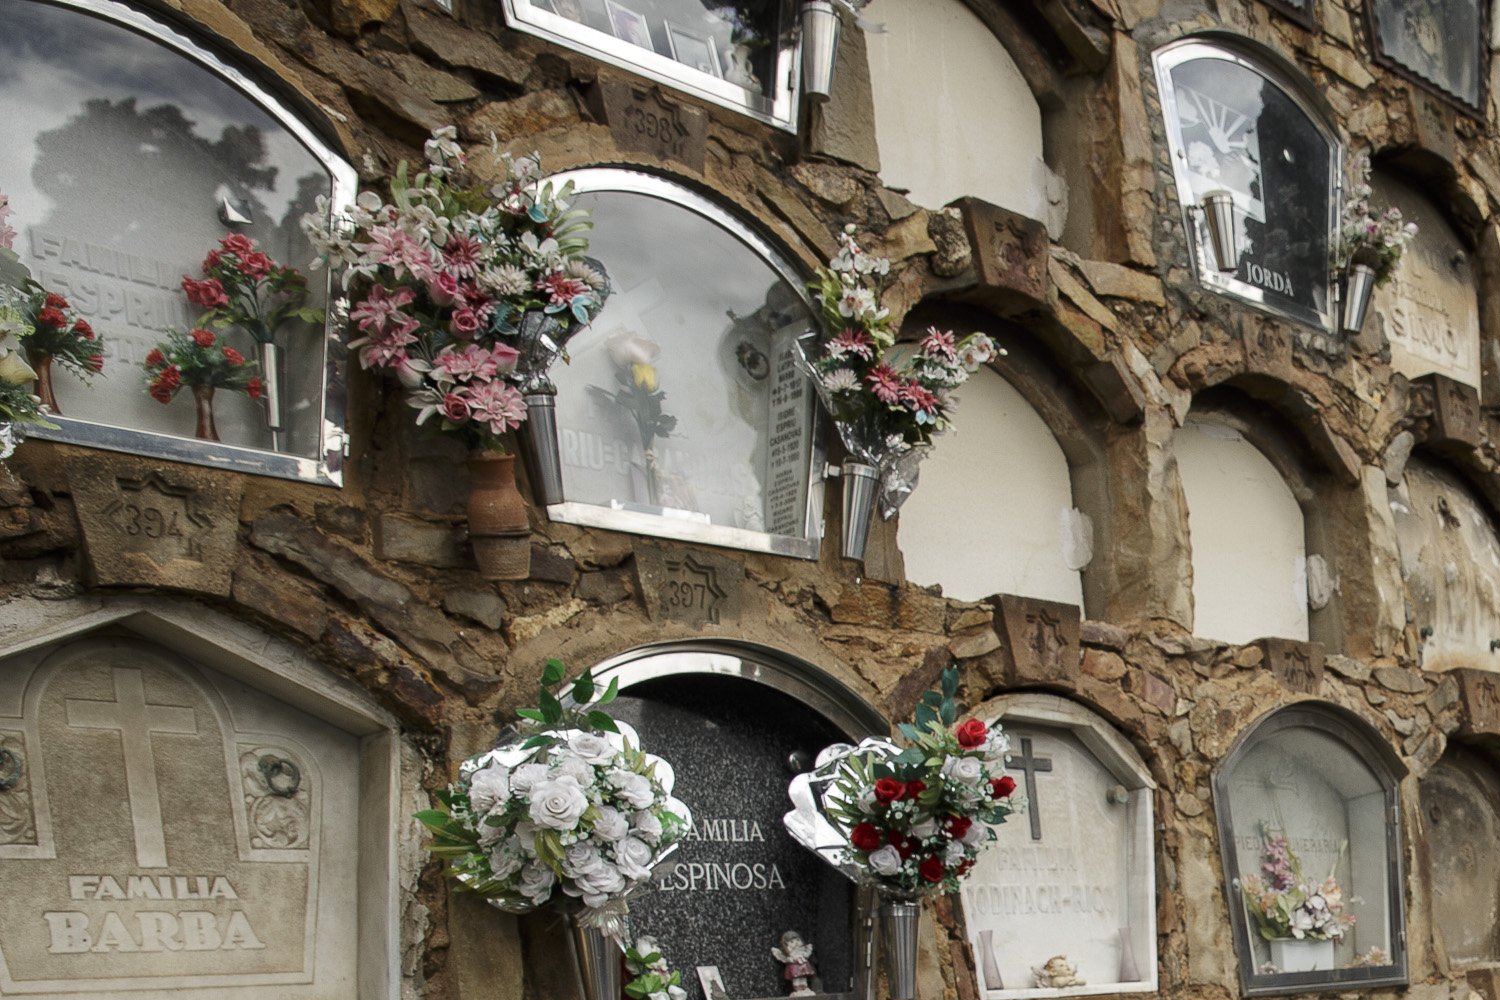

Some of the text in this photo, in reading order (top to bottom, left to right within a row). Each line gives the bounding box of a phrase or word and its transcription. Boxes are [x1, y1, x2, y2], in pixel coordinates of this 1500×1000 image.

[634, 107, 673, 144] 398
[1246, 260, 1295, 297] JORDÀ
[125, 504, 185, 539] 394
[669, 580, 706, 609] 397
[676, 819, 766, 842] AMILIA
[68, 874, 239, 901] FAMILIA
[659, 862, 786, 891] ESPINOSA
[42, 909, 267, 955] BARBA
